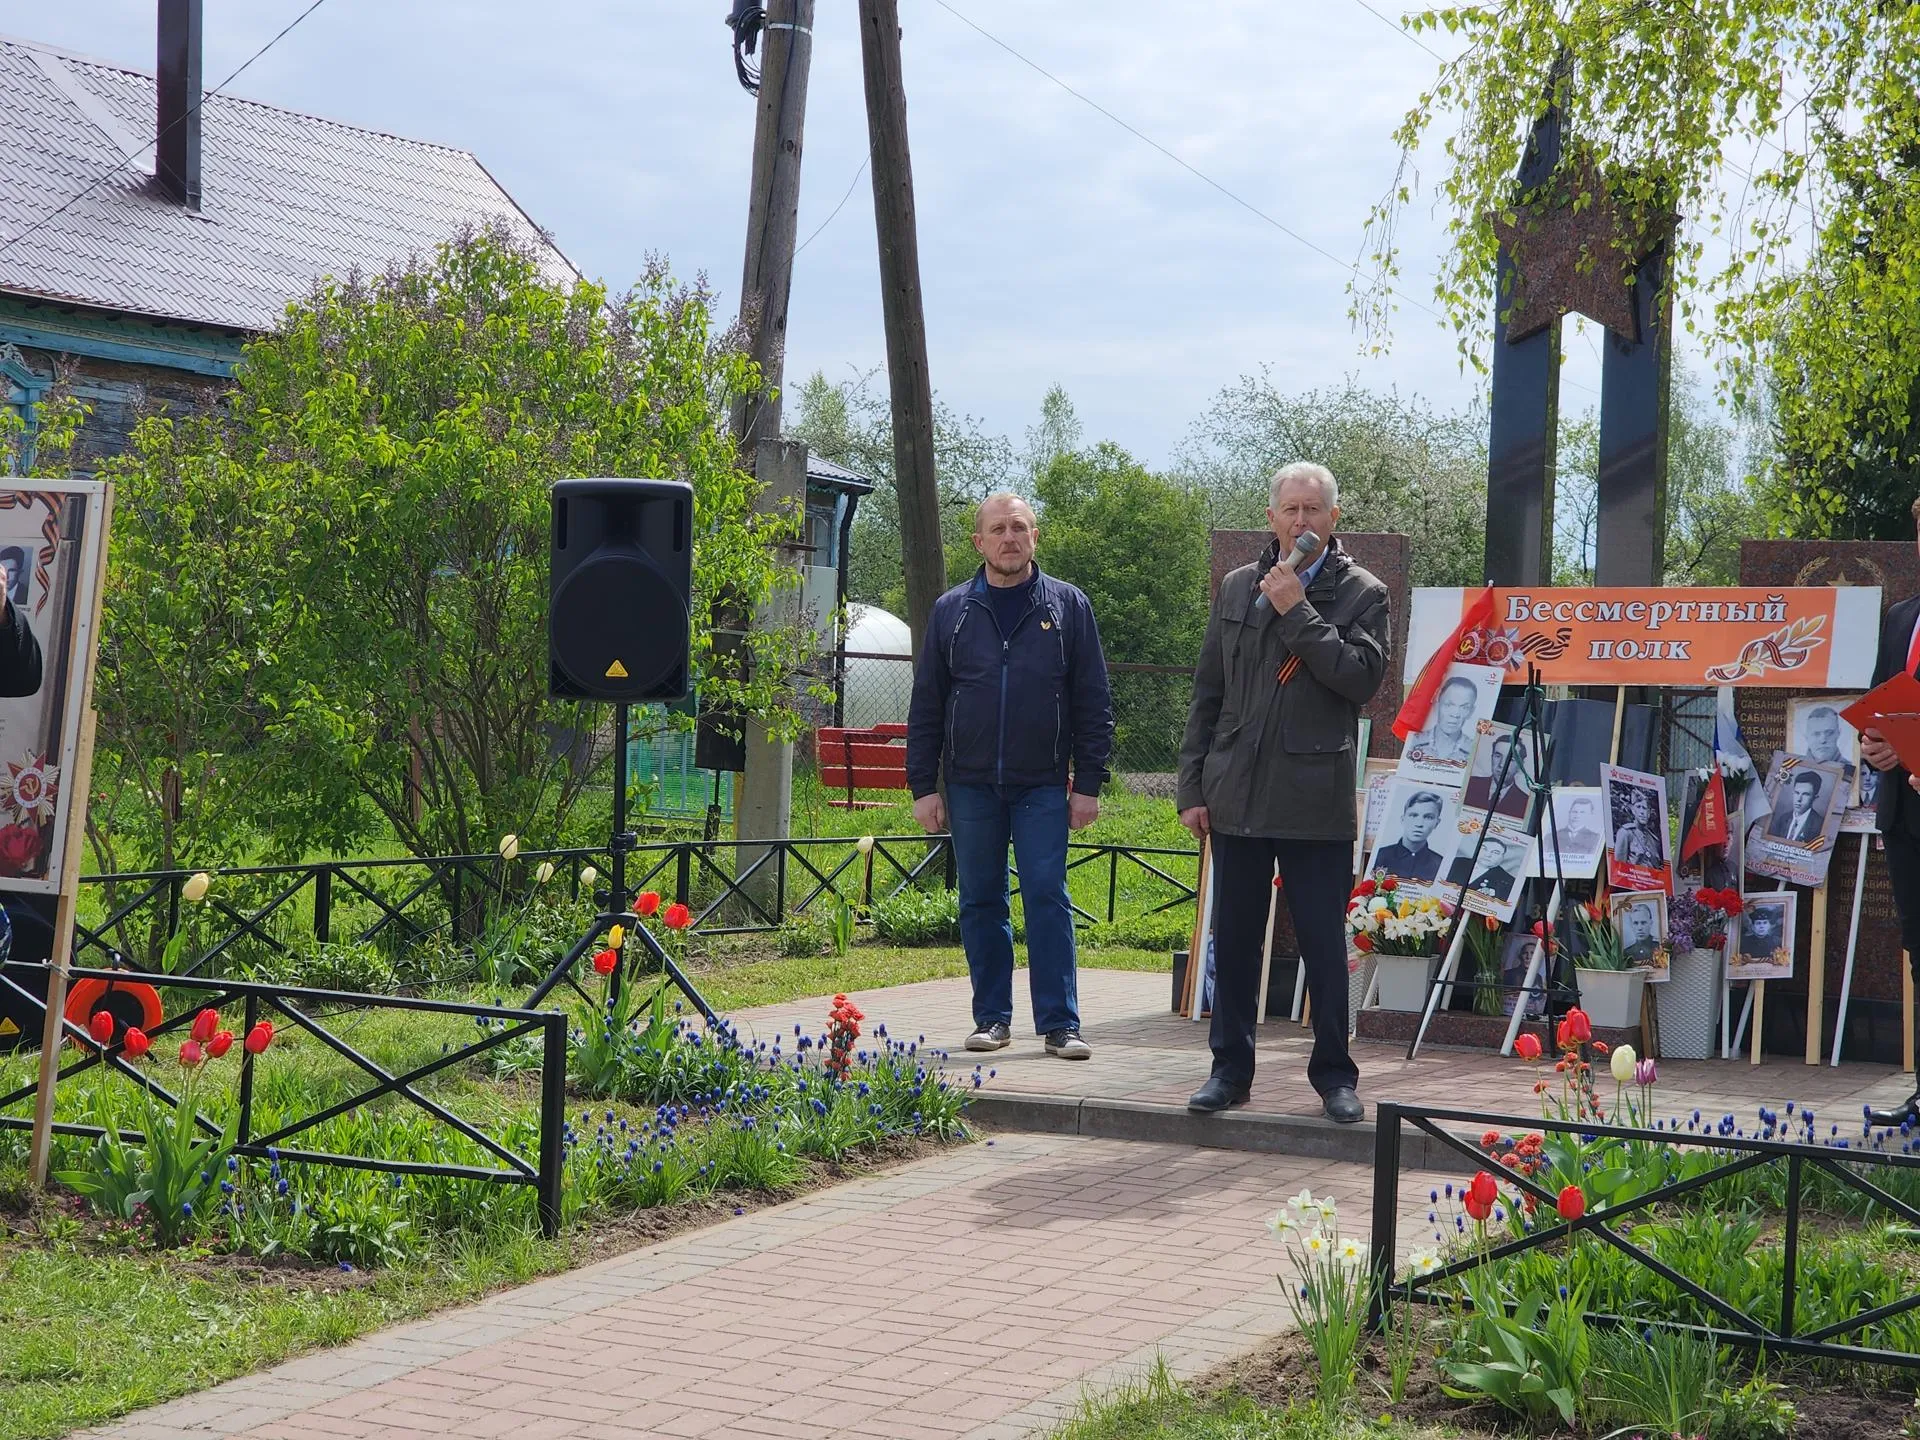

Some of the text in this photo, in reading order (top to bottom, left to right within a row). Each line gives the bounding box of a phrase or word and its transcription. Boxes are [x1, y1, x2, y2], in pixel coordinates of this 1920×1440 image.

[1504, 594, 1788, 630] Бессмертный
[1587, 639, 1692, 661] полк
[1740, 699, 1787, 709] САБАНИН
[1740, 712, 1787, 723] САБАНИН
[1747, 739, 1786, 749] АБАНИН
